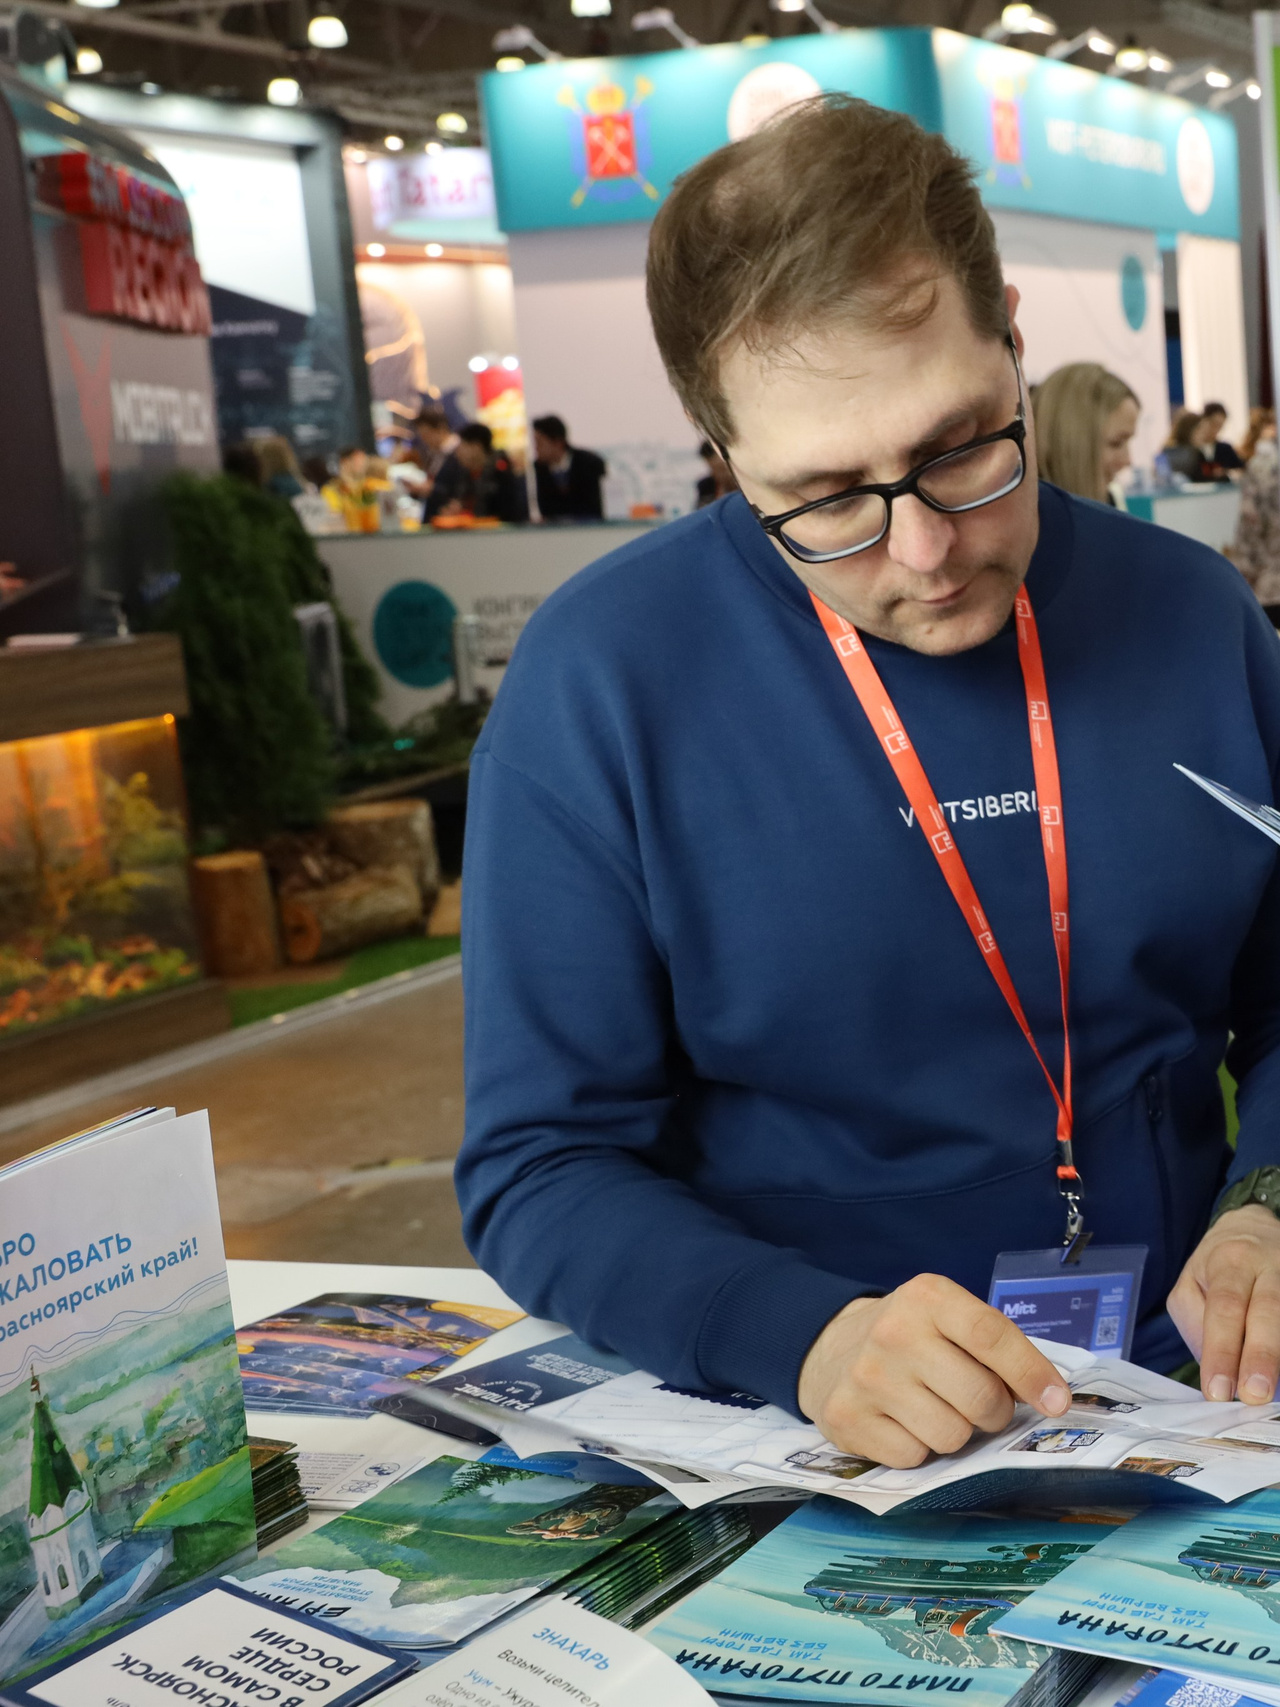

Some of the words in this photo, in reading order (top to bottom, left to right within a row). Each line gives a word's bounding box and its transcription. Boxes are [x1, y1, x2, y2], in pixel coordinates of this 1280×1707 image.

[140, 1237, 198, 1277] край!
[1081, 1599, 1130, 1616] ГОРЫ
[1099, 1592, 1170, 1615] ВЕРШИН
[1172, 1607, 1210, 1619] БЕЗ
[1131, 1610, 1165, 1622] ГДЕ
[718, 1628, 791, 1647] ВЕРШИН
[792, 1638, 828, 1650] БЕЗ
[1057, 1610, 1241, 1656] ПУТОРАНА
[250, 1627, 361, 1677] РОССИИ
[532, 1627, 610, 1671] ЗНАХАРЬ
[229, 1646, 332, 1692] СЕРДЦЕ
[497, 1649, 546, 1677] Возьми
[676, 1648, 853, 1687] ПУТОРАНА
[181, 1655, 281, 1701] САМОМ
[464, 1668, 494, 1688] Учум
[858, 1672, 974, 1693] ПЛАТО
[445, 1681, 476, 1701] Одно
